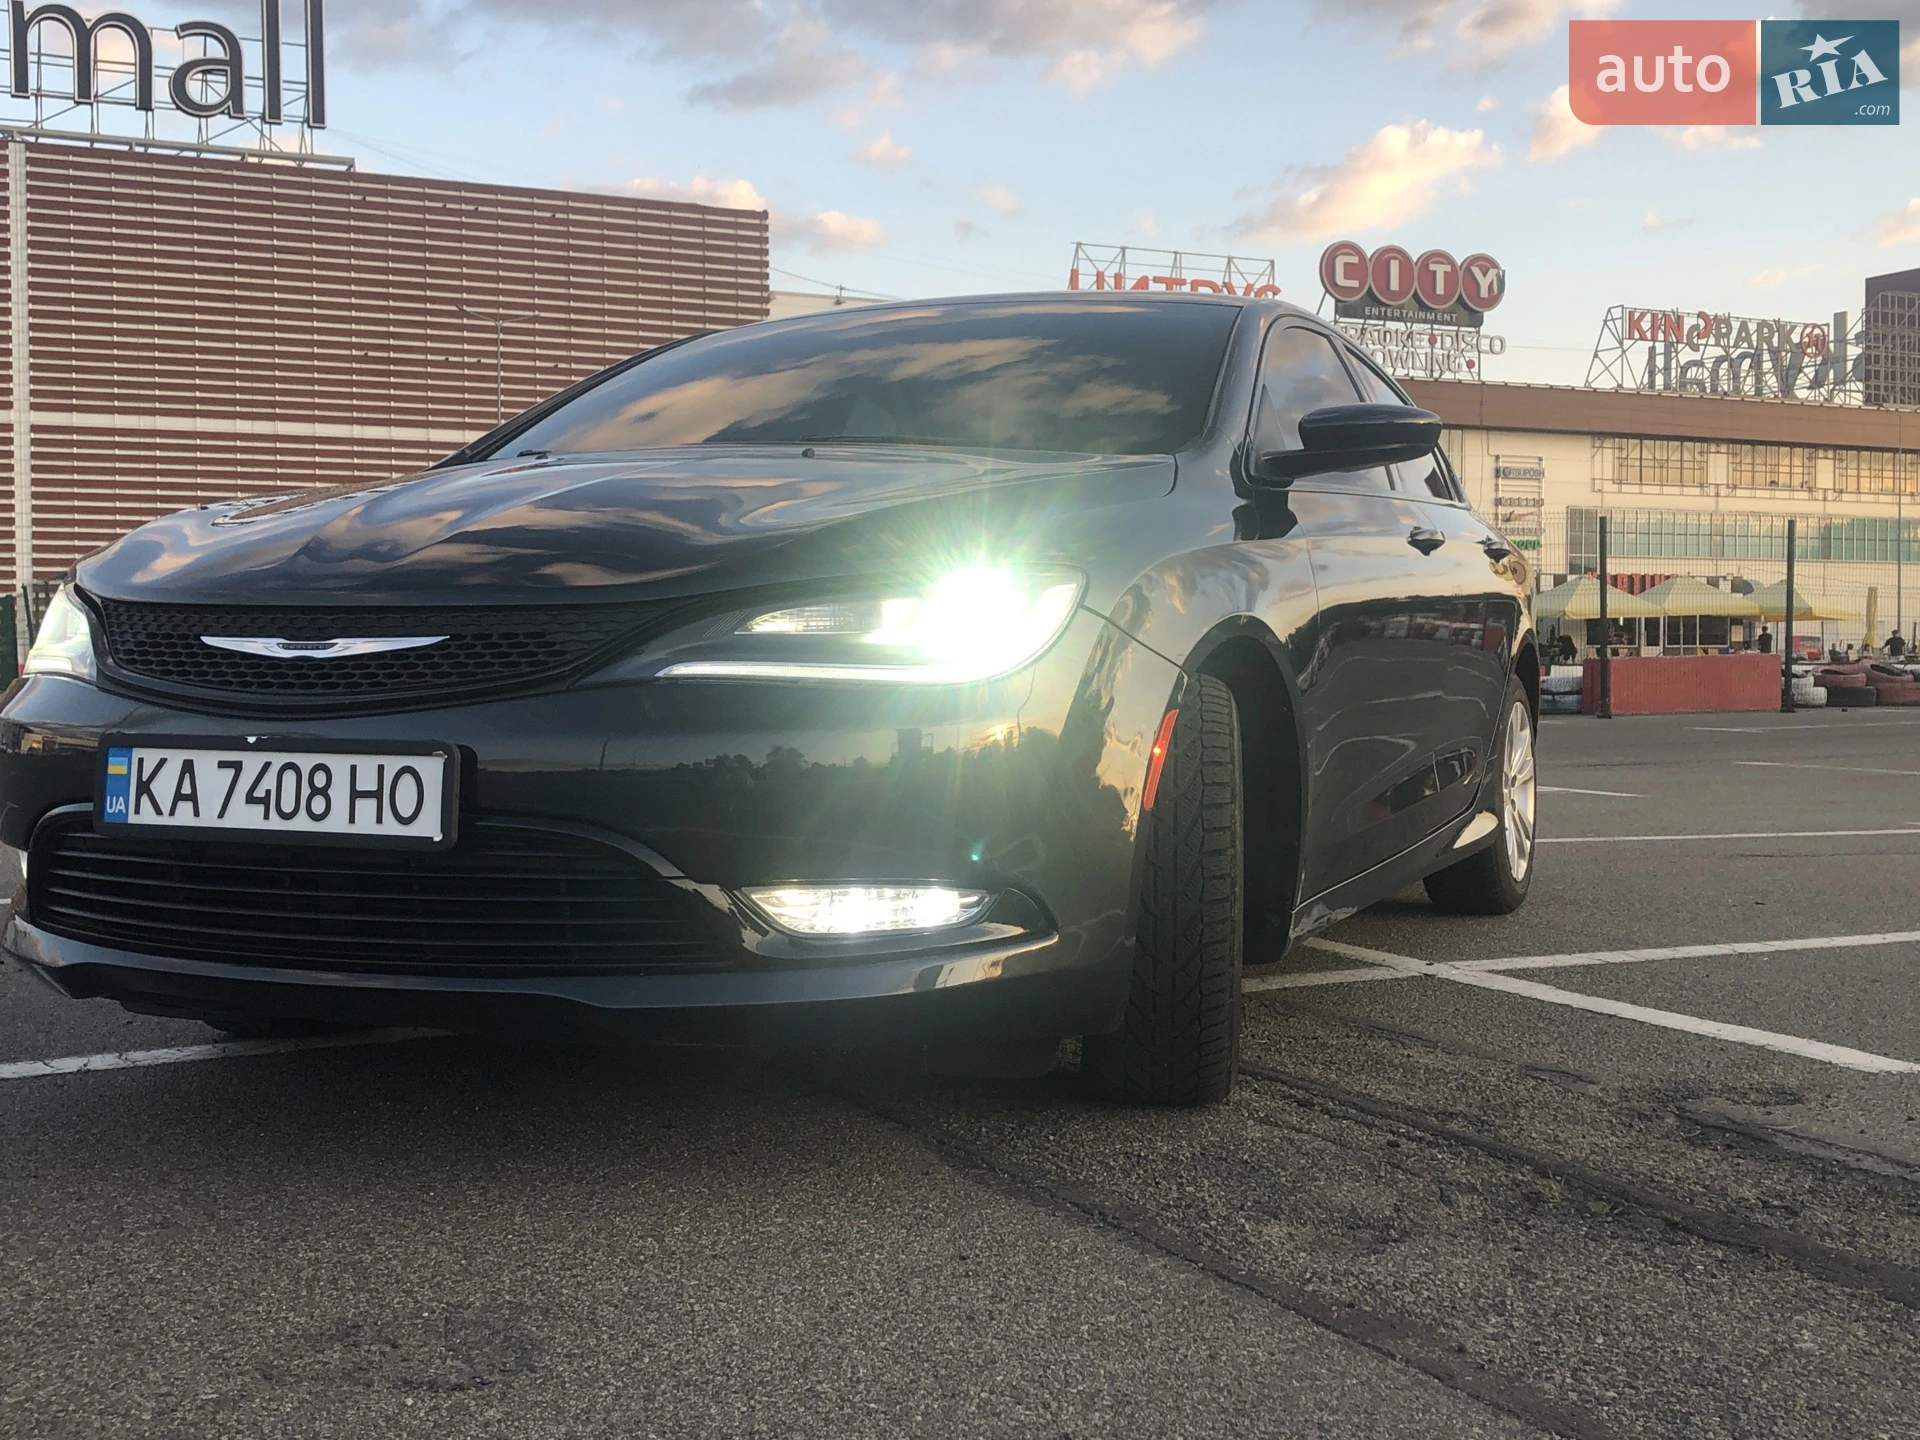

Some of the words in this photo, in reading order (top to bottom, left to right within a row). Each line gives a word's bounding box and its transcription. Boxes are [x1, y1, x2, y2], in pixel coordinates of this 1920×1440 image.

[9, 0, 326, 128] mall
[1334, 254, 1499, 299] CITY
[1364, 305, 1458, 323] ENTERTAINMENT
[1440, 331, 1507, 355] DISCO
[1371, 346, 1463, 374] OWLING
[106, 795, 127, 814] UA
[134, 756, 200, 818] KA
[216, 760, 334, 822] 7408
[348, 763, 425, 826] HO
